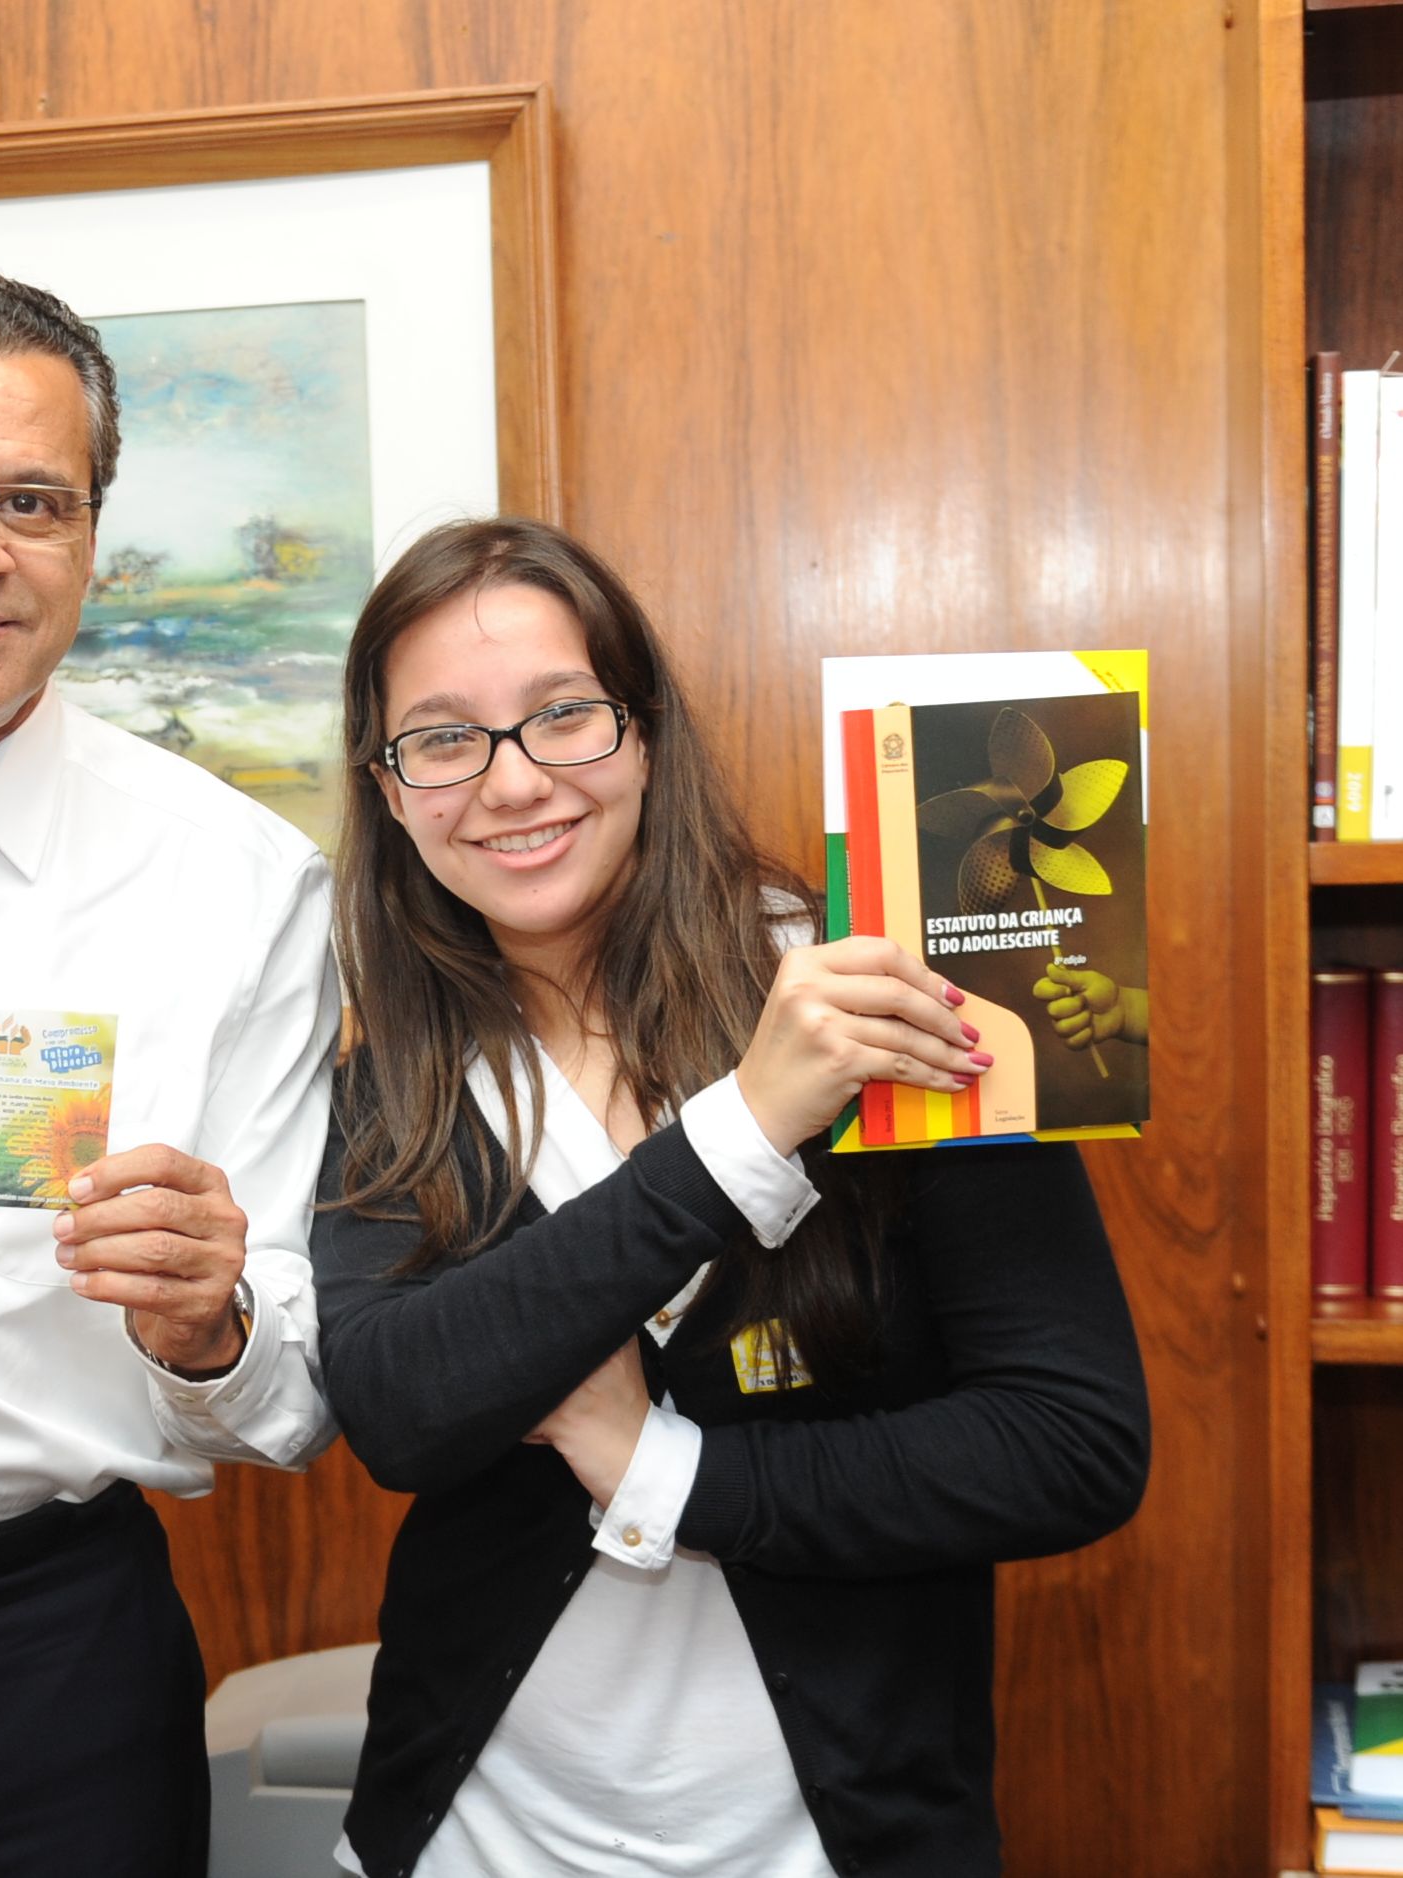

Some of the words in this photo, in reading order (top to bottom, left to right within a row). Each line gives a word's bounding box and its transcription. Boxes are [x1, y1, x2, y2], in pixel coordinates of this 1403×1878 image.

[926, 914, 996, 935] ESTATUTO
[998, 911, 1018, 929] DA
[1020, 907, 1083, 928] CRIANÇA
[928, 938, 937, 955] E
[939, 937, 960, 954] DO
[961, 929, 1060, 952] ADOLESCENTE
